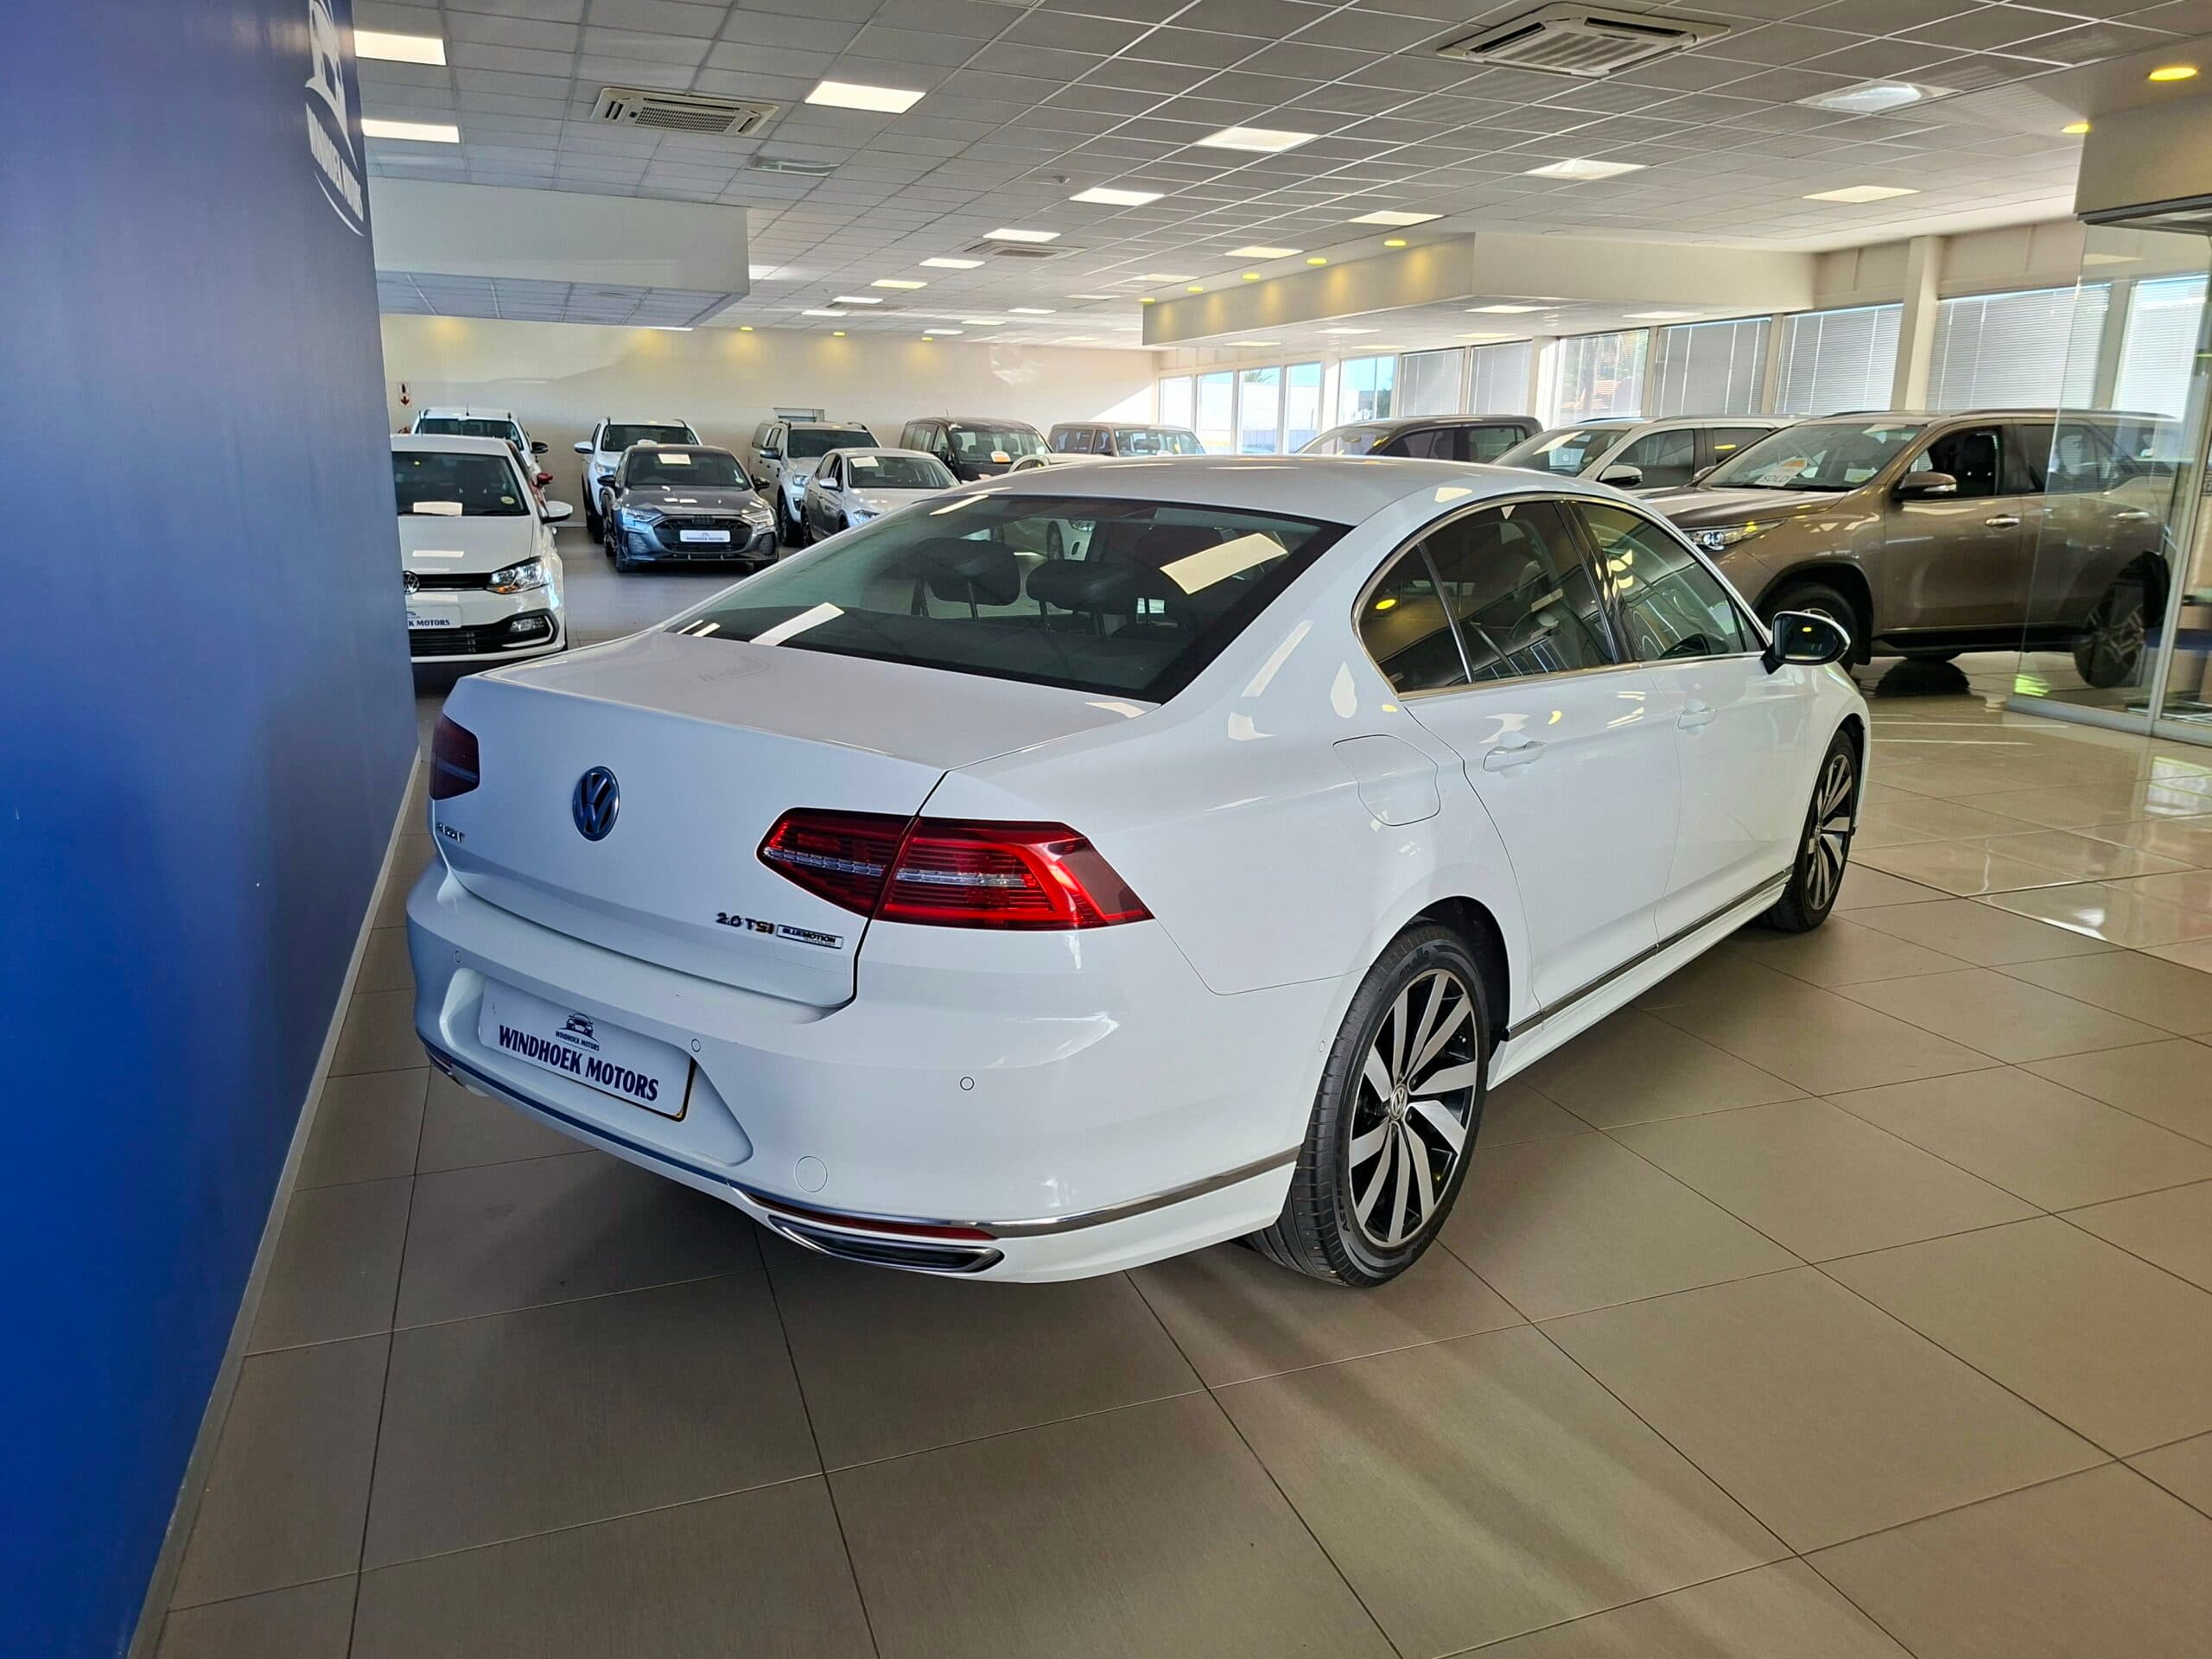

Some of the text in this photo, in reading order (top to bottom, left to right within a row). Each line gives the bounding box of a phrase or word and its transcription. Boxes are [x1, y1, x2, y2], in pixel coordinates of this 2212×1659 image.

[715, 912, 741, 927] 2.0
[745, 918, 774, 935] TSI
[499, 1025, 659, 1102] WINDHOEK MOTORS
